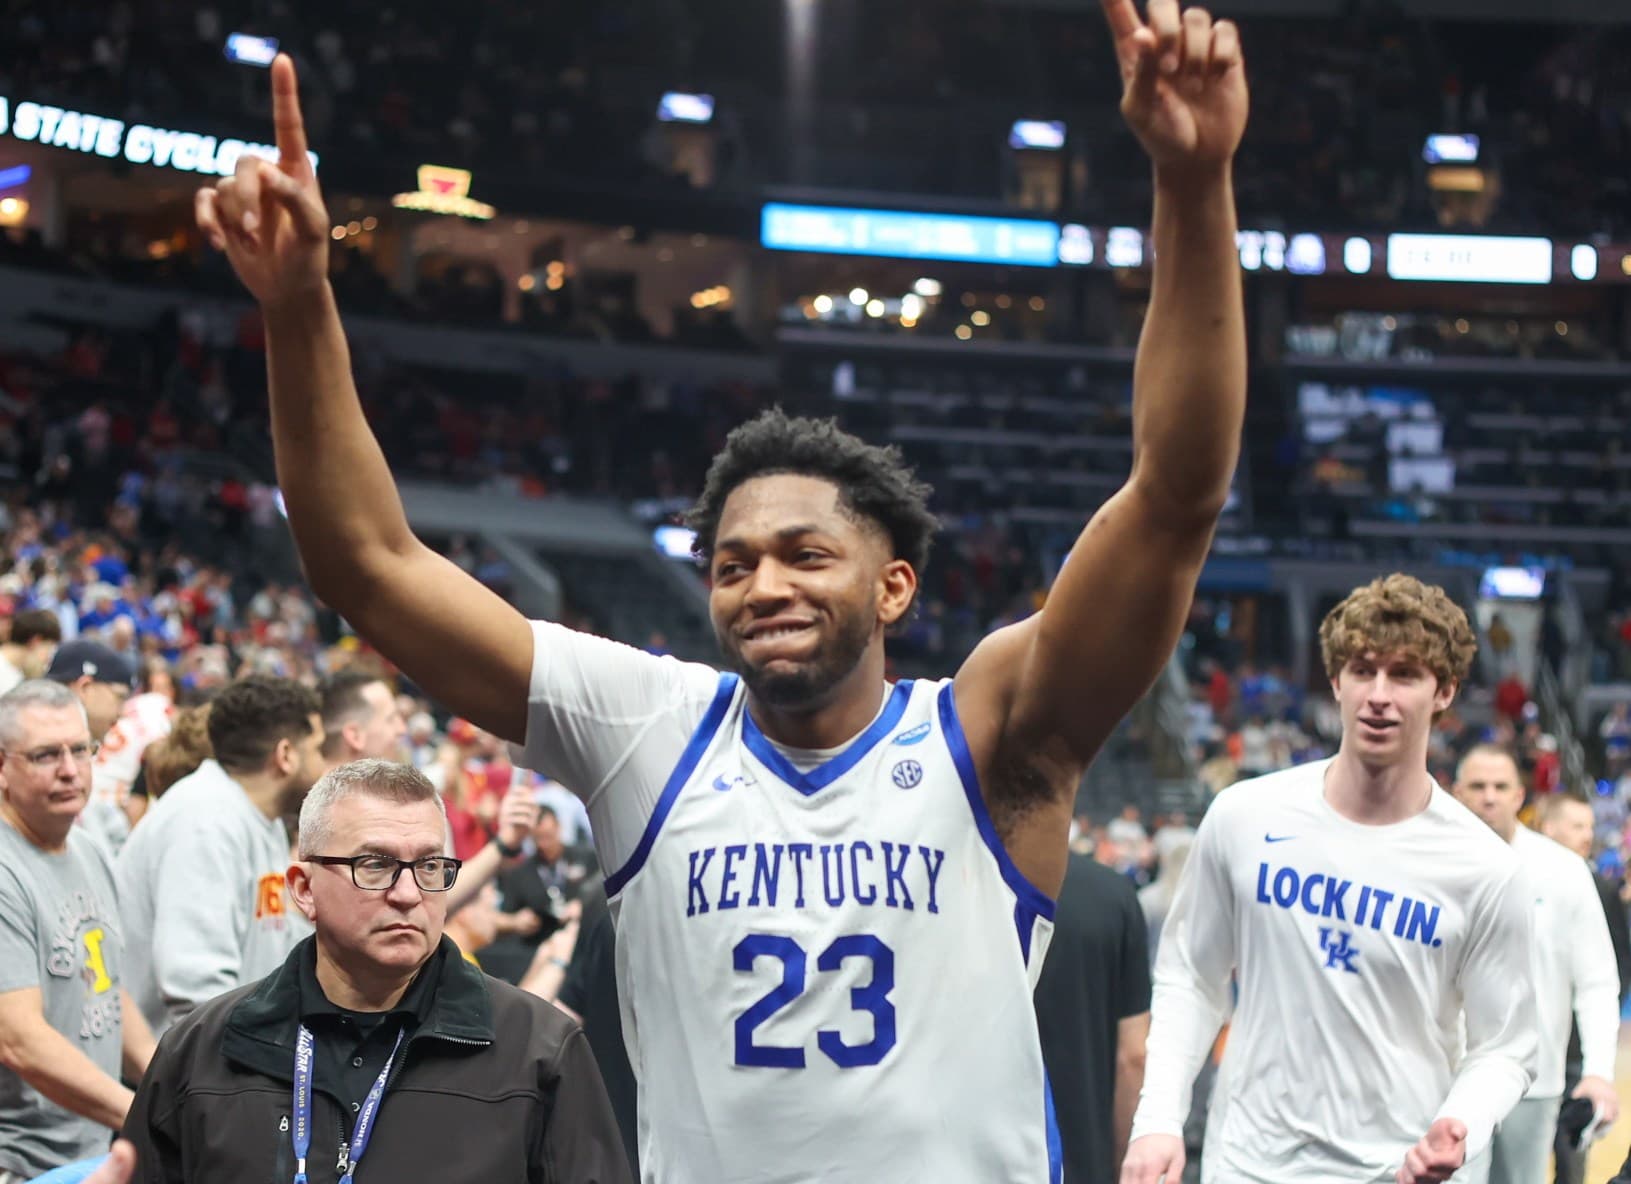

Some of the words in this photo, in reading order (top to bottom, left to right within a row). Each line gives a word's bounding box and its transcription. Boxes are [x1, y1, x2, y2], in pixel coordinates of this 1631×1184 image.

[12, 101, 125, 158] STATE
[124, 124, 319, 176] CYCLO
[893, 761, 922, 788] SEC
[687, 841, 945, 917] KENTUCKY
[1256, 862, 1352, 921] LOCK
[1354, 885, 1394, 931] IT
[1393, 897, 1442, 948] IN.
[1318, 926, 1360, 974] UK
[733, 934, 896, 1069] 23
[298, 1087, 306, 1109] LOUIS
[358, 1101, 374, 1139] HONDA
